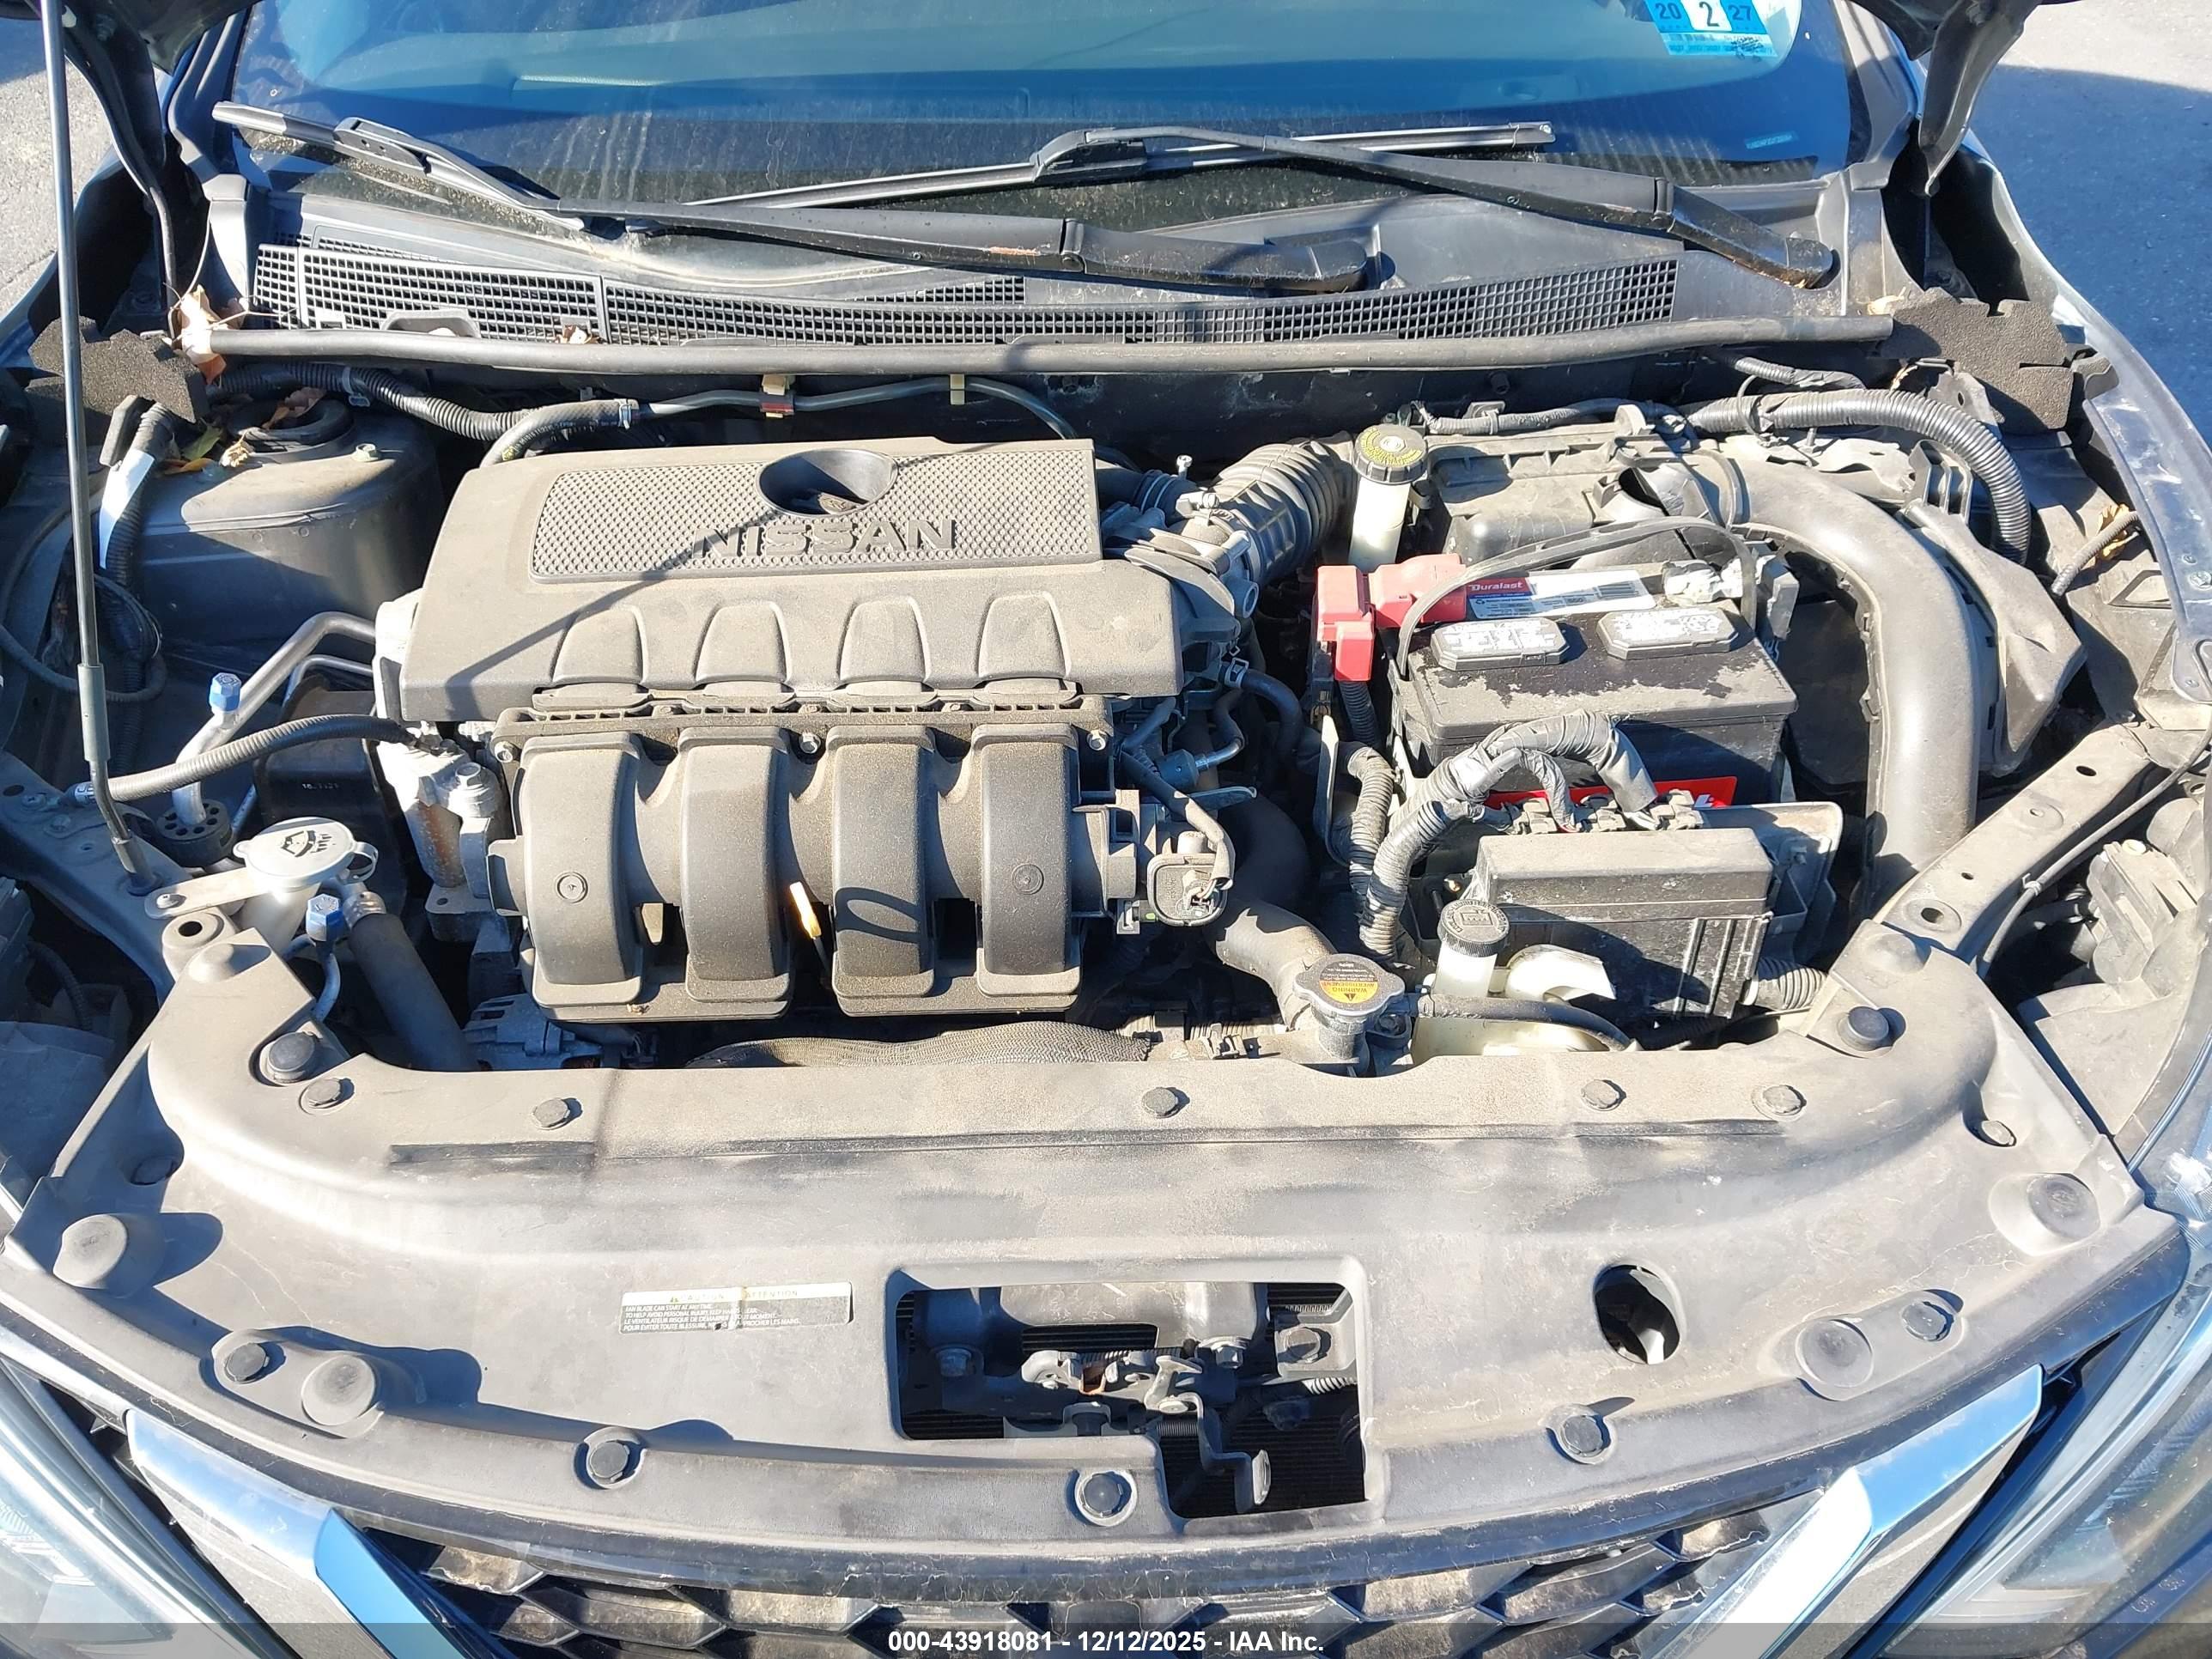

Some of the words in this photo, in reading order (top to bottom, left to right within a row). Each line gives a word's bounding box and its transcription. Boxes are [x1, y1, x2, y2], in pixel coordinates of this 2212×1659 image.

[1655, 3, 1681, 20] 20
[1698, 2, 1720, 27] 2
[1728, 4, 1751, 21] 27
[690, 519, 955, 559] NISSAN
[1468, 581, 1523, 591] Duralast
